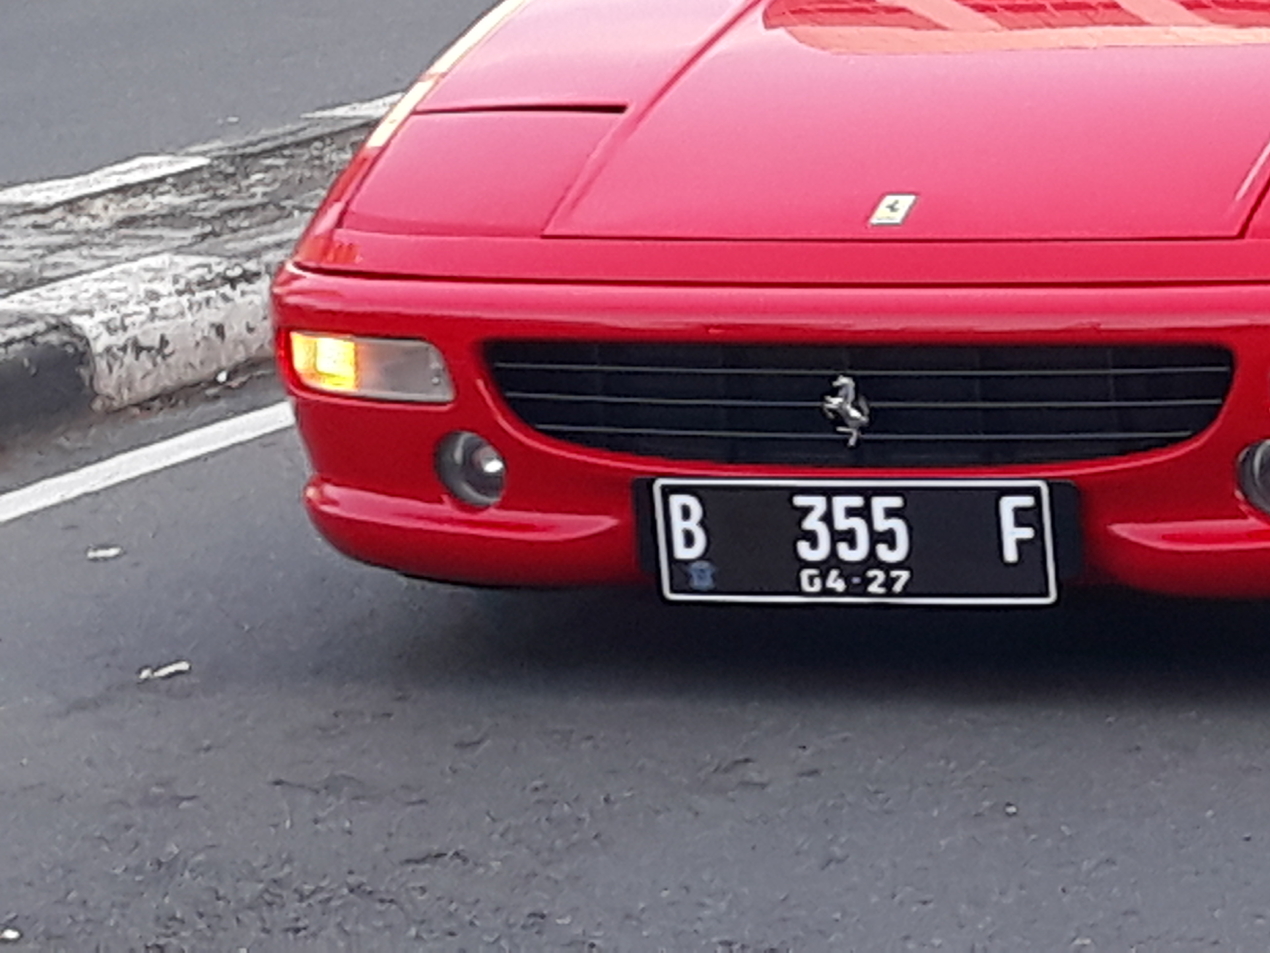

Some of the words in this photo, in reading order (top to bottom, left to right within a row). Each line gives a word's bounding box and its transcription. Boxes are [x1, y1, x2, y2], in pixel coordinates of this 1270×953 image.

[669, 494, 707, 560] B
[792, 495, 911, 563] 355
[998, 495, 1036, 564] F
